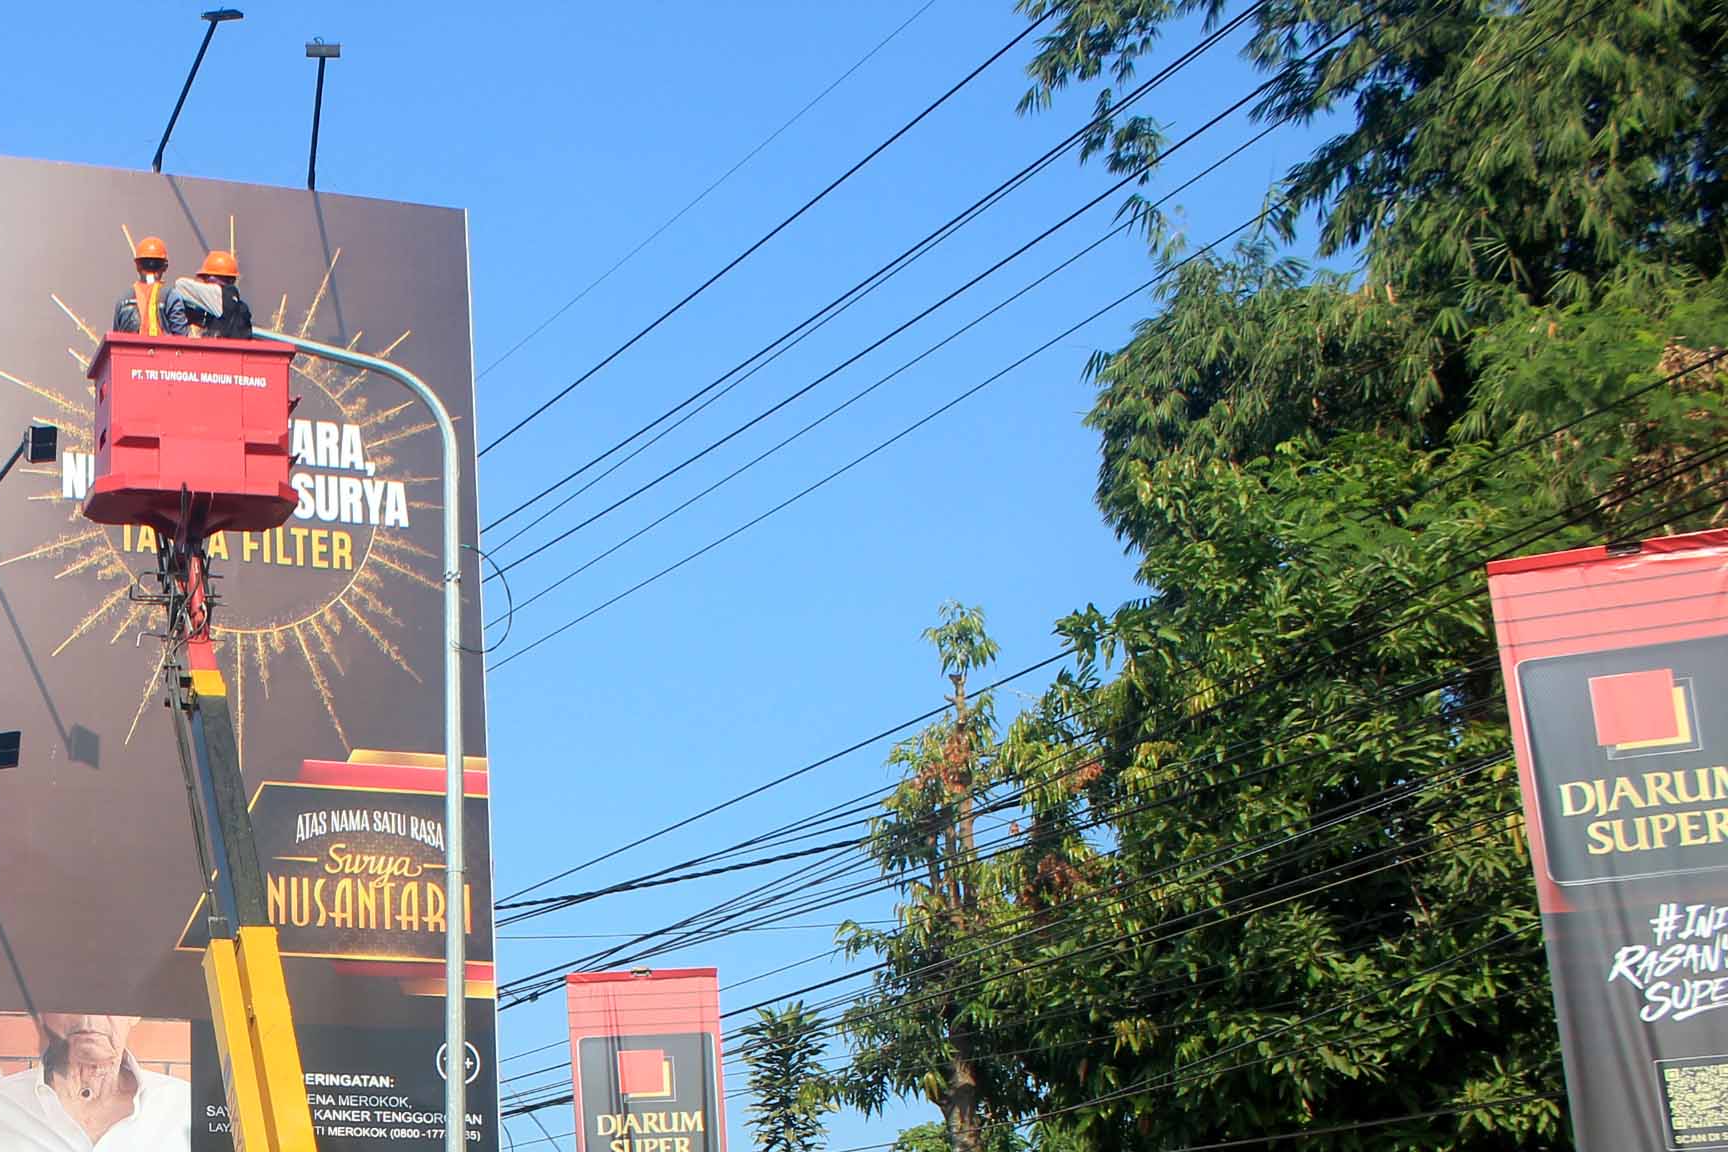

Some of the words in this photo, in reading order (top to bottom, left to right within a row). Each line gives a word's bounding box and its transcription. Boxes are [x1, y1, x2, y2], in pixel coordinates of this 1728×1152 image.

[131, 369, 143, 380] PT.
[145, 369, 158, 380] TRI
[160, 370, 199, 382] TUNGGAL
[200, 372, 232, 384] MADIUN
[234, 375, 267, 387] TERANG
[291, 473, 409, 527] SURYA
[242, 525, 353, 571] FILTER
[1559, 766, 1728, 817] DJARU
[296, 810, 326, 844] ATAS
[330, 809, 370, 833] NAMA
[373, 810, 407, 836] SATU
[410, 815, 445, 851] RASA
[324, 843, 422, 889] Surya
[303, 1072, 396, 1088] ERINGATAN:
[338, 1094, 412, 1109] MEROKOK,
[313, 1109, 371, 1122] KANKER
[596, 1110, 704, 1138] DJARUM
[327, 1126, 387, 1139] MEROKOK
[1674, 1134, 1706, 1144] SCAN
